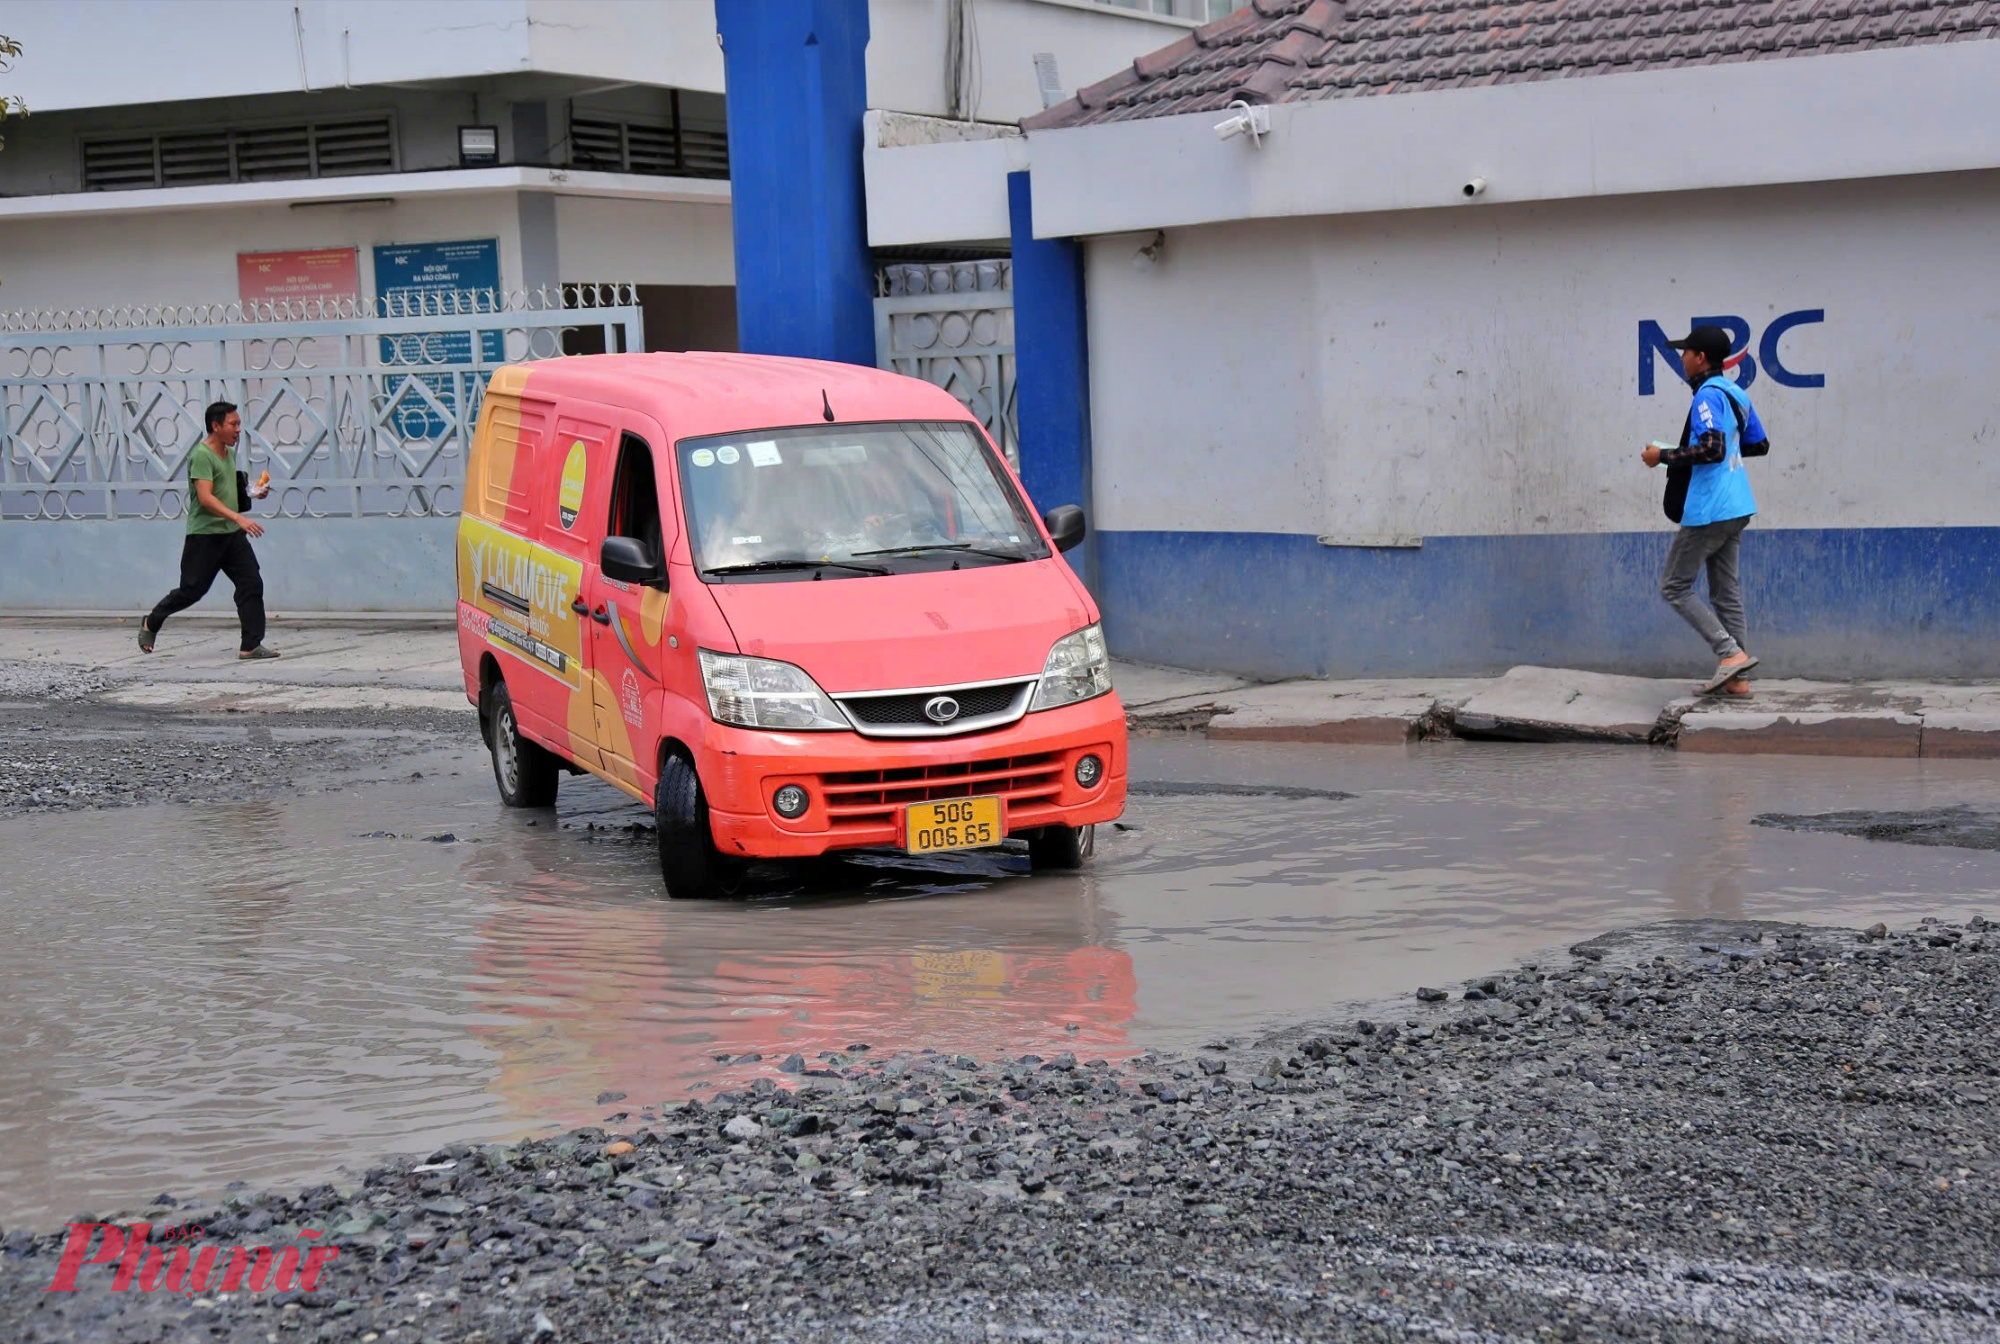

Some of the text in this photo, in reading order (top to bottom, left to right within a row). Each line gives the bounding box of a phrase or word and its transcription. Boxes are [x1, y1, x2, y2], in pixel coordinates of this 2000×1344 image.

[487, 541, 569, 621] LALAMOVE
[934, 801, 973, 825] 50G
[918, 822, 991, 850] 006.65
